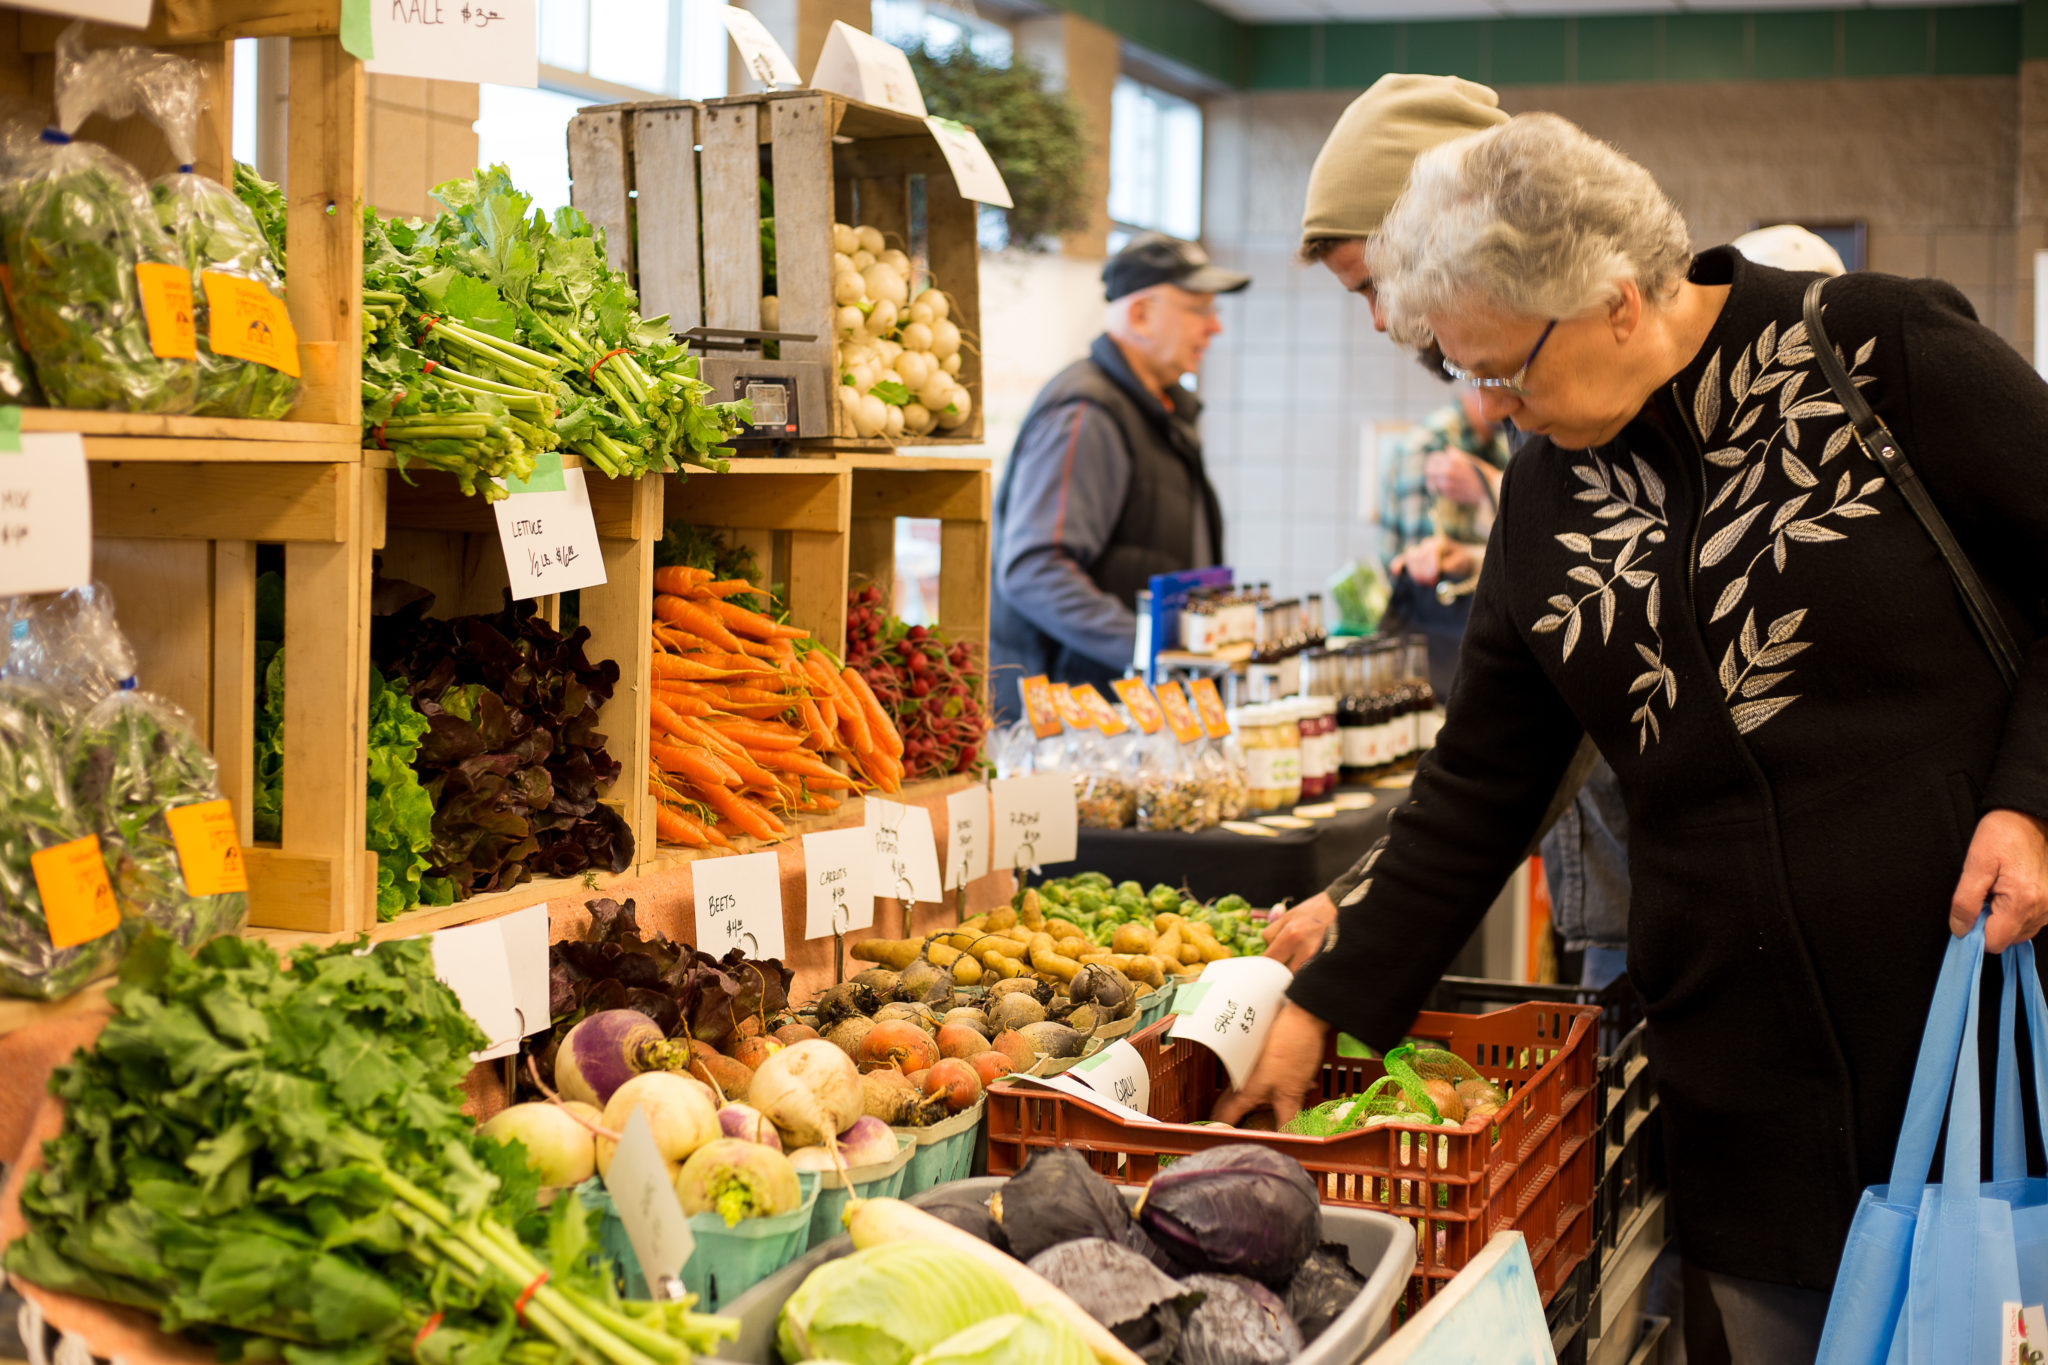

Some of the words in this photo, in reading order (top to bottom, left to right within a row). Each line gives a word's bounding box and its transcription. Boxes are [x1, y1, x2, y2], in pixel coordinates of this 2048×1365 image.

[392, 0, 445, 25] KALE
[511, 519, 543, 538] LETTUCE
[708, 894, 736, 917] BEETS
